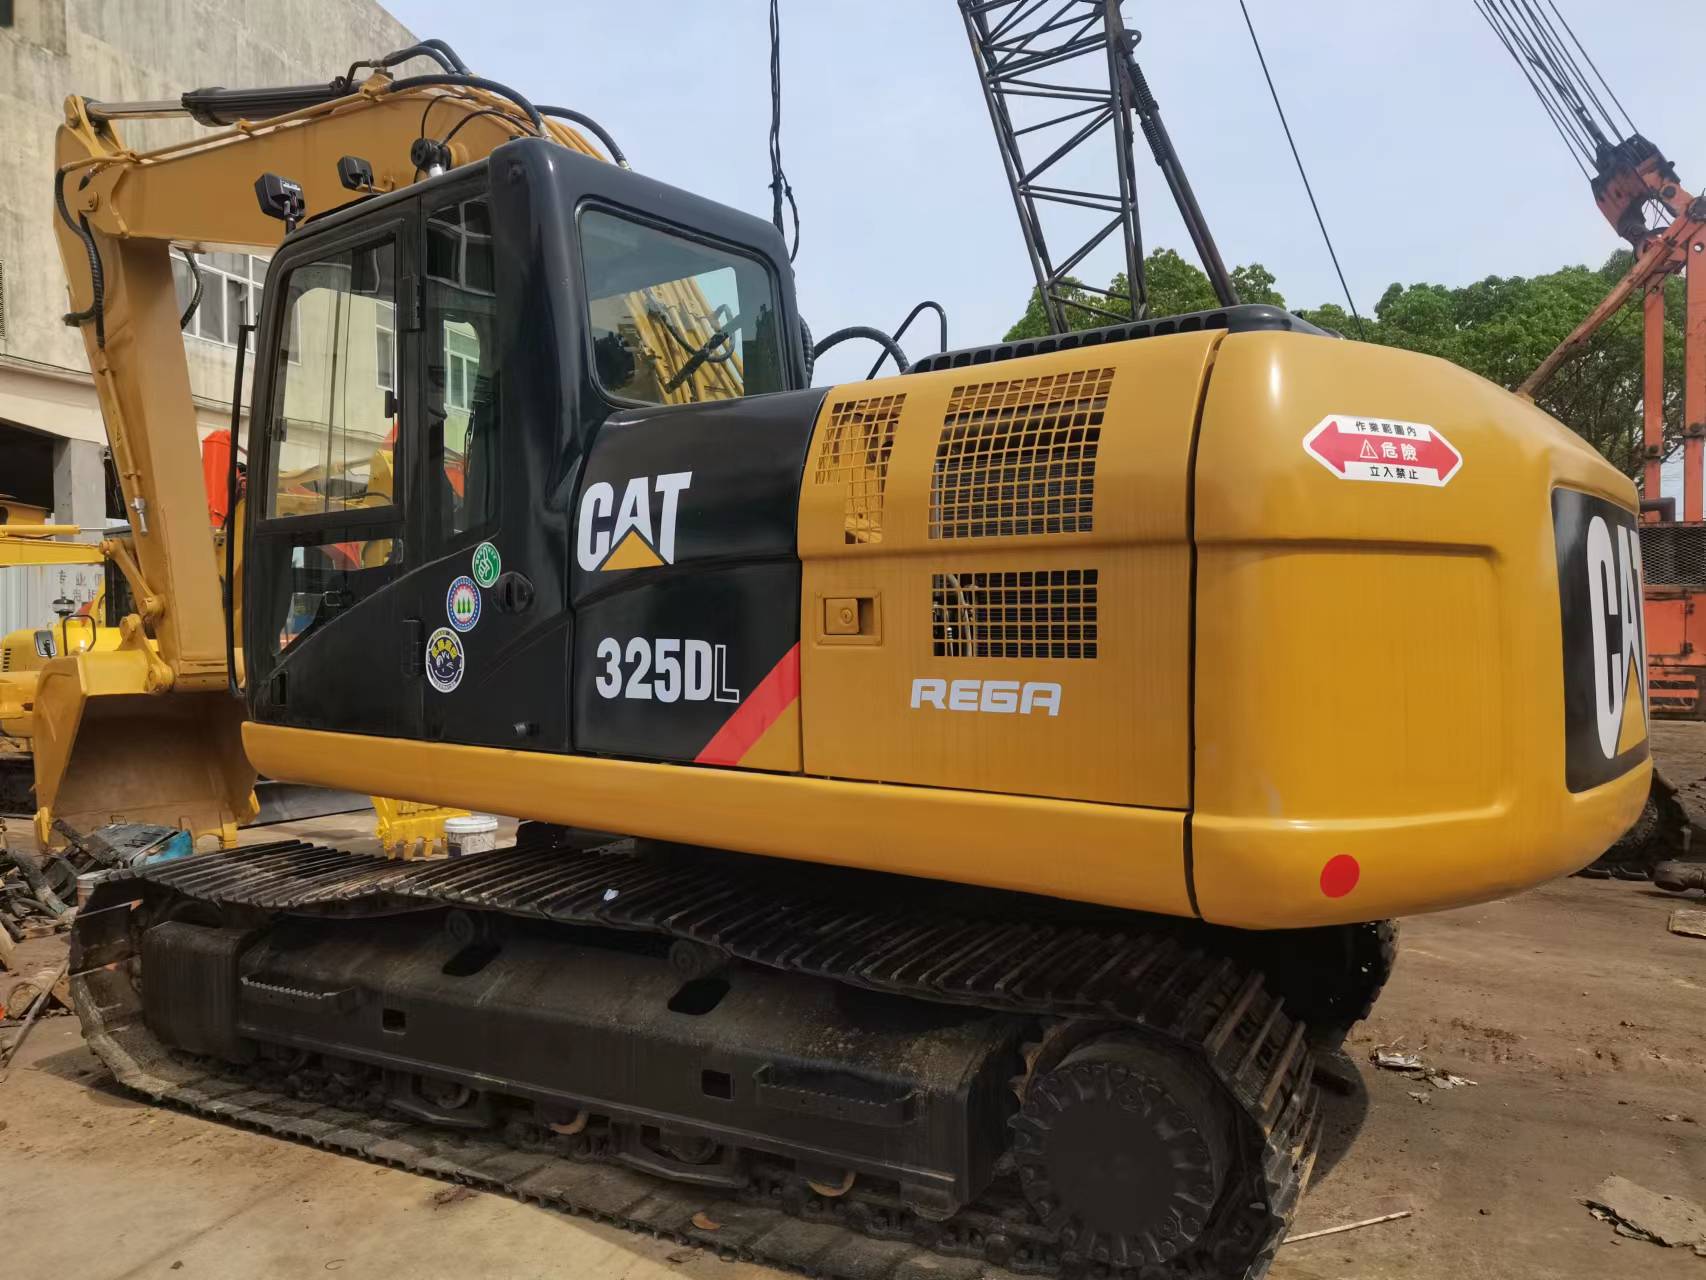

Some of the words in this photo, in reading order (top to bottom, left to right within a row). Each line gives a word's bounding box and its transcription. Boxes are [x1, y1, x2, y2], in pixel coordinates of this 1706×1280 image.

[1369, 465, 1419, 480] 立入禁止
[577, 471, 693, 572] CAT
[595, 636, 740, 704] 325DL
[910, 678, 1062, 717] REGA
